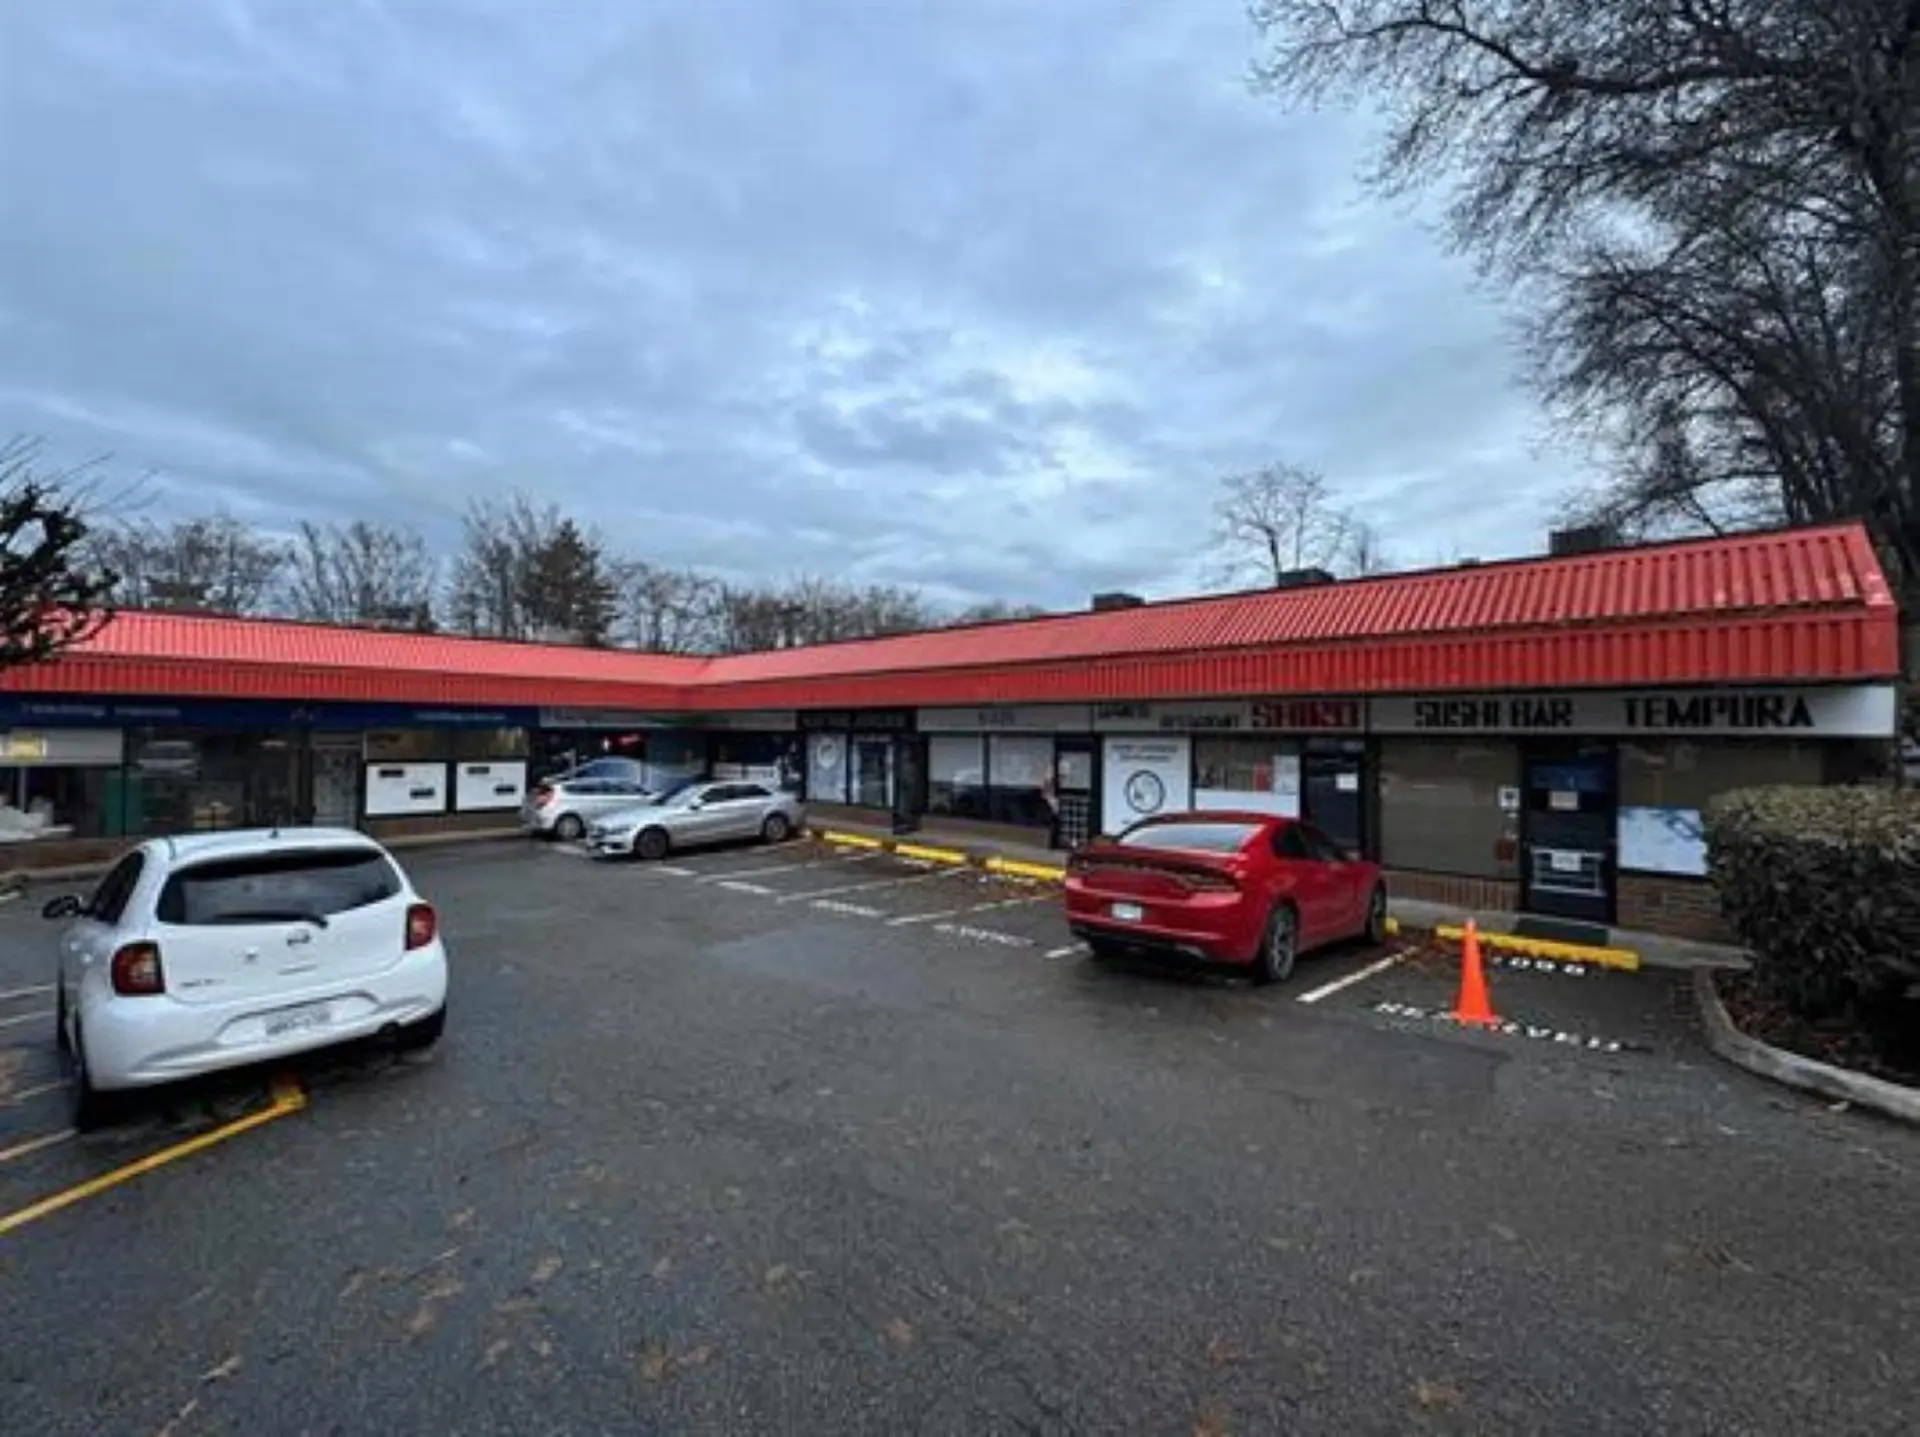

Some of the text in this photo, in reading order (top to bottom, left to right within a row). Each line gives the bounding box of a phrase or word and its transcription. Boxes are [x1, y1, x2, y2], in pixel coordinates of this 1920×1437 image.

[1414, 694, 1816, 728] SUSHI BAR TEMPURA
